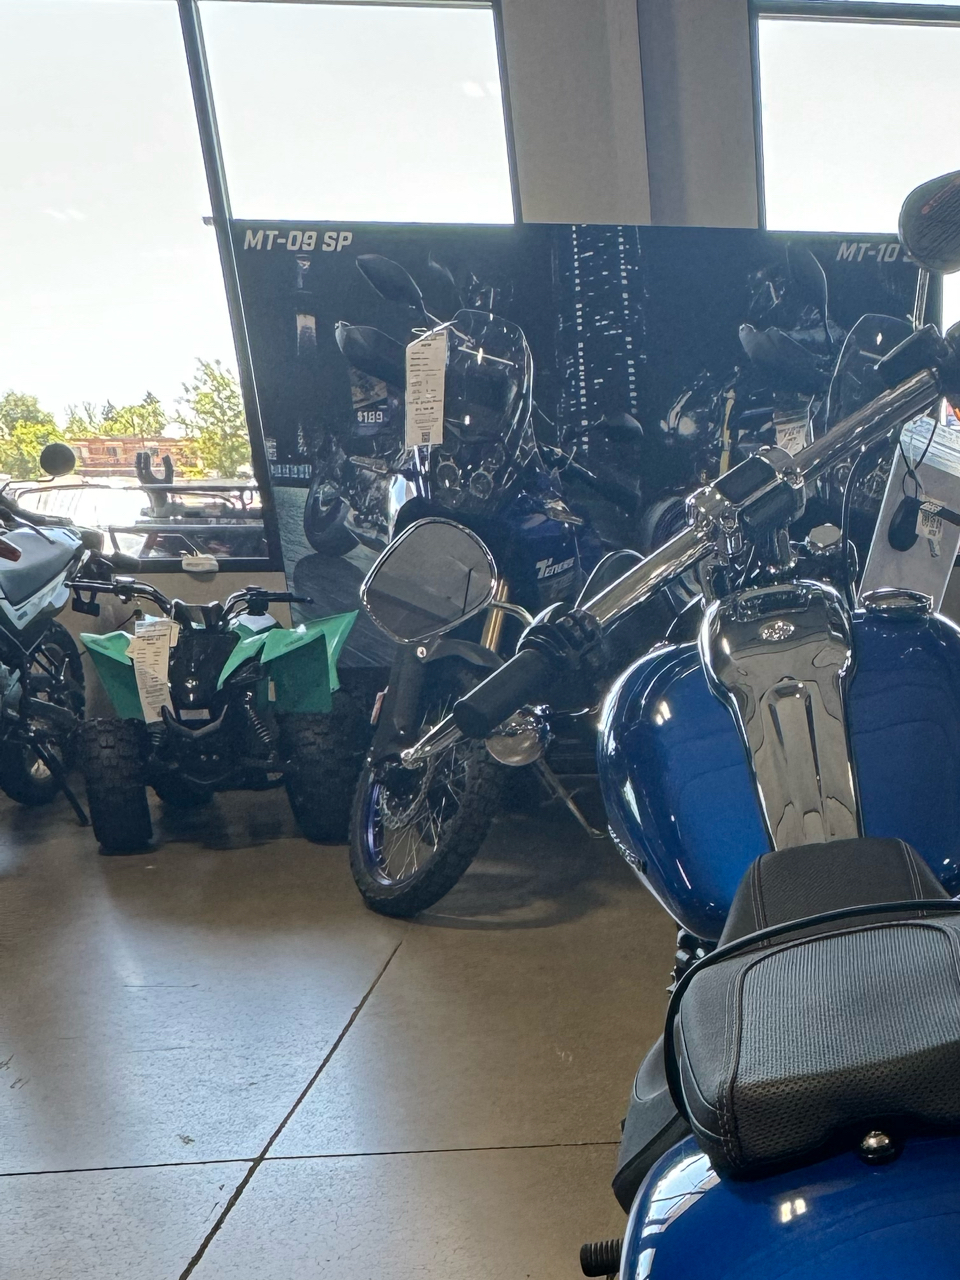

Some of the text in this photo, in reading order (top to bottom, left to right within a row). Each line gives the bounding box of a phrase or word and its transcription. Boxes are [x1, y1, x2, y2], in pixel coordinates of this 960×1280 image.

[244, 229, 353, 252] MT-09 SP
[836, 241, 901, 262] MT-10
